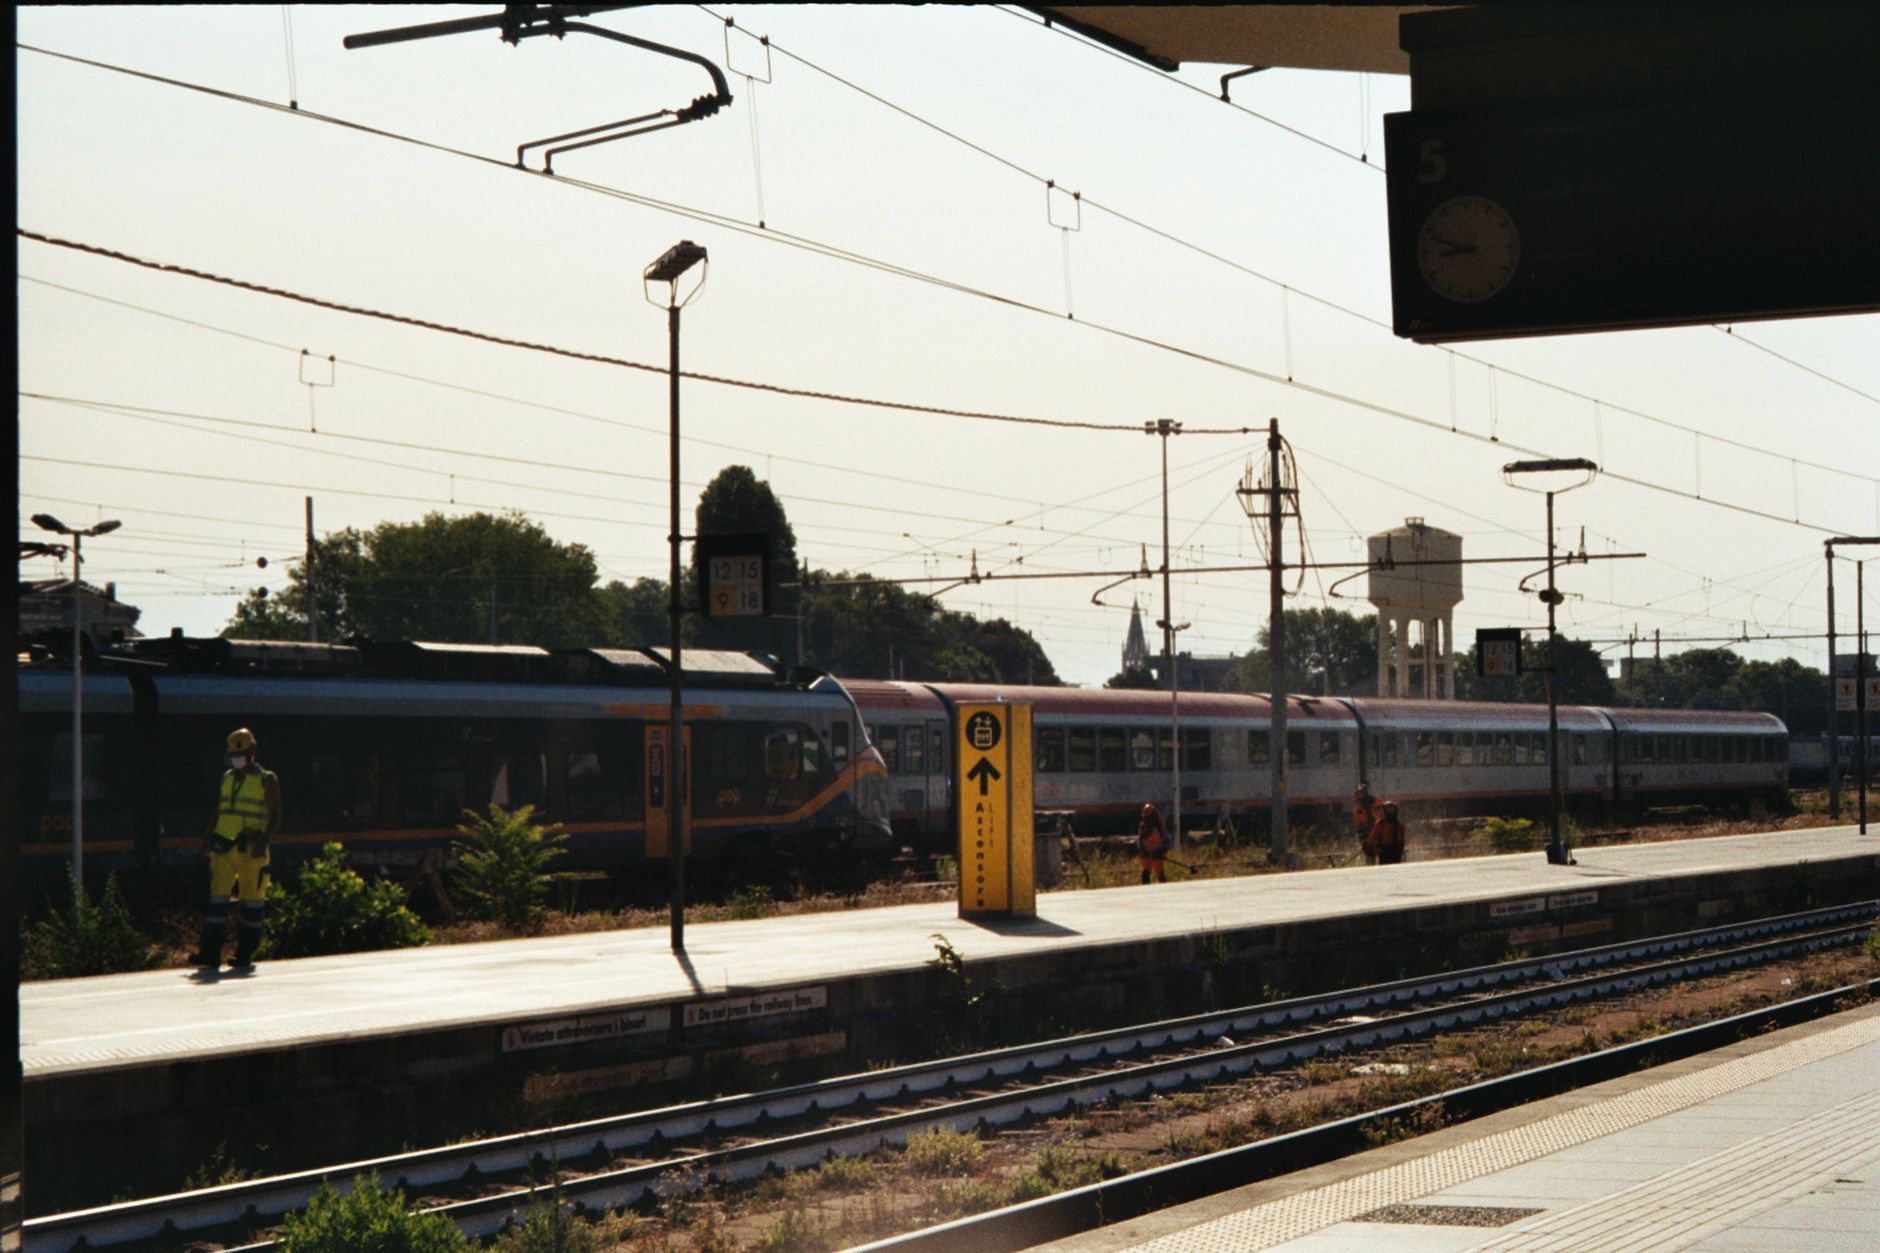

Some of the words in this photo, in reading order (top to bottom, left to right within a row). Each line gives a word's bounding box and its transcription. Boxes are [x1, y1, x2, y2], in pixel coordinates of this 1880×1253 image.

[1416, 138, 1449, 185] 5
[713, 561, 733, 580] 12
[740, 560, 758, 578] 15
[717, 592, 729, 609] 9
[741, 592, 758, 609] 18
[976, 803, 985, 907] Ascensore
[698, 1007, 710, 1021] Do
[712, 1005, 727, 1019] not
[727, 1003, 748, 1017] cross
[750, 999, 762, 1013] the
[763, 997, 793, 1014] railway
[794, 994, 812, 1007] lines
[520, 1027, 555, 1044] Vietato
[556, 1021, 613, 1038] attraversare
